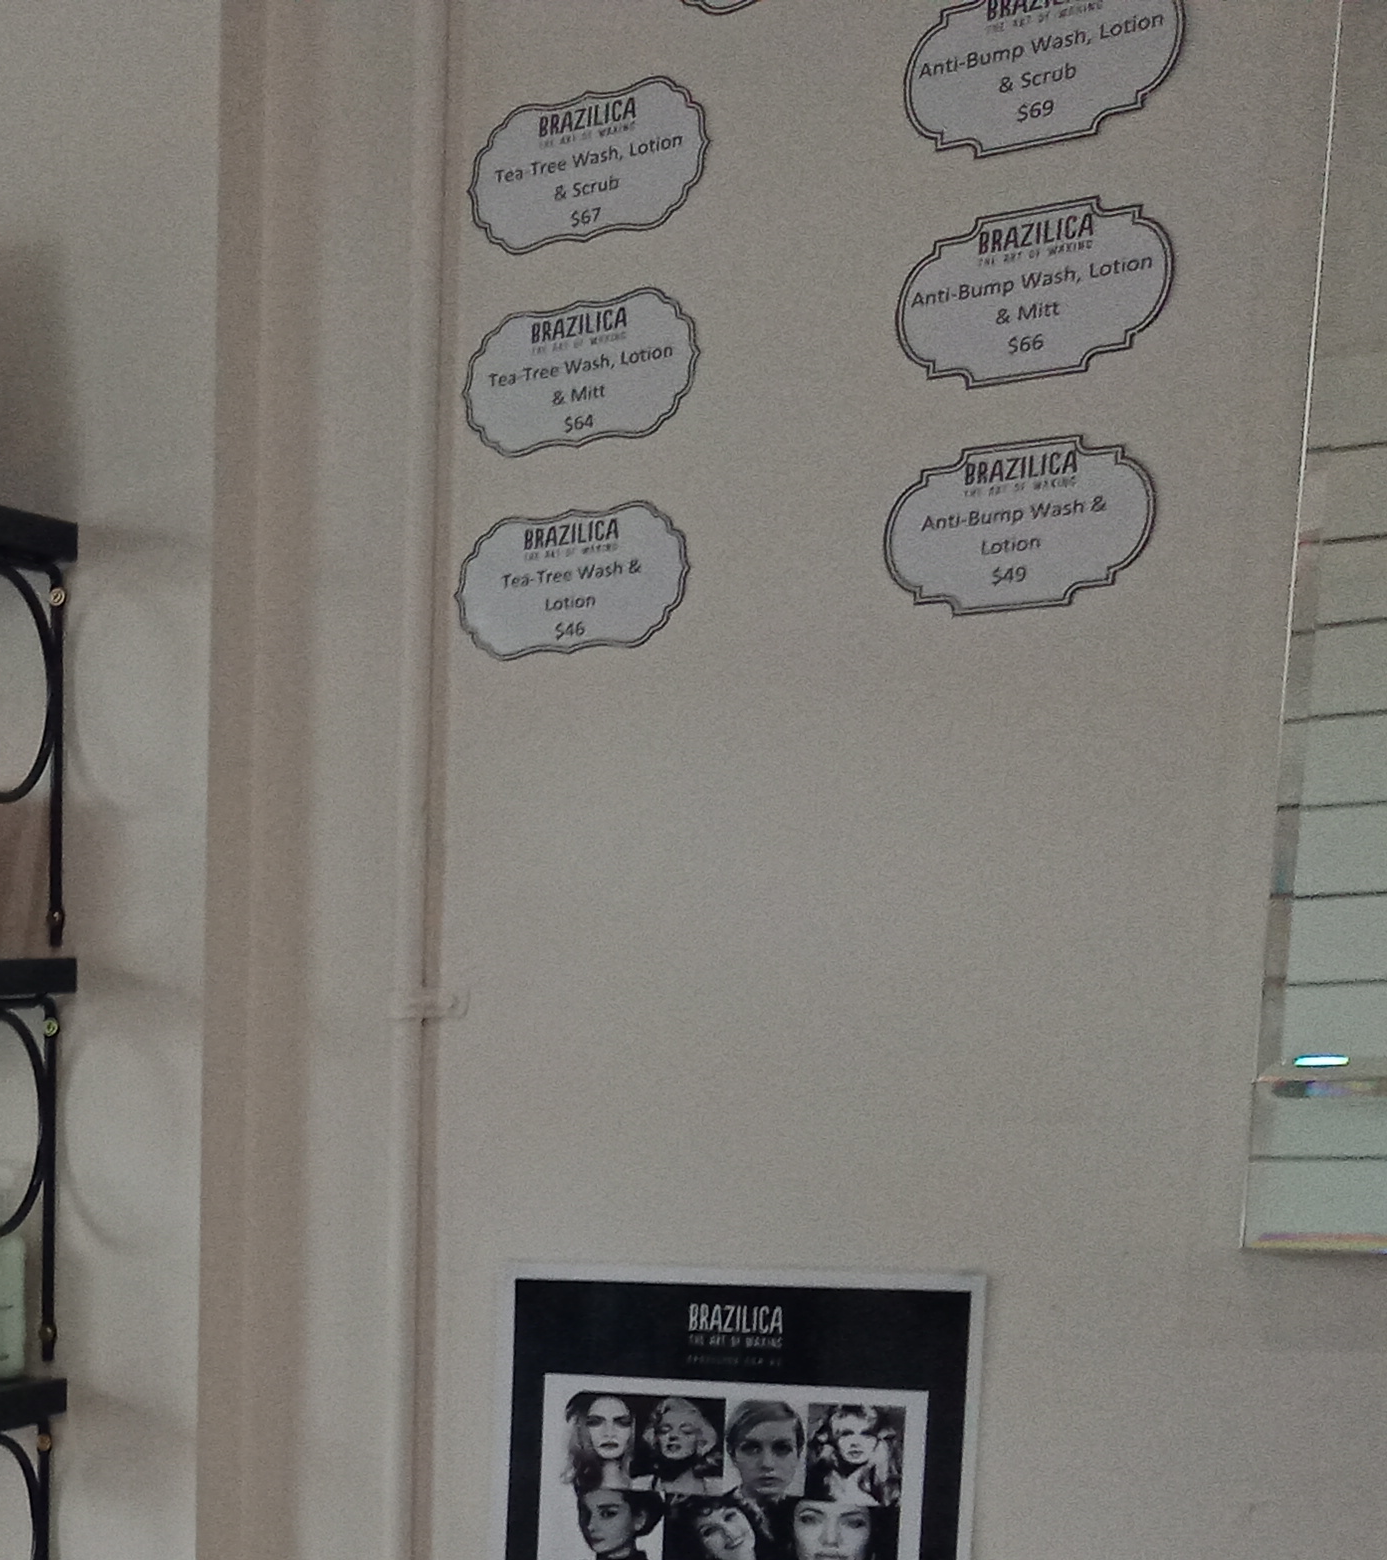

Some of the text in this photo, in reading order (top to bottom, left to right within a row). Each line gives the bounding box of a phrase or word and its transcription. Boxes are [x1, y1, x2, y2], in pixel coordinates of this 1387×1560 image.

[918, 13, 1165, 79] Anti-Bump Wash, Lotion
[999, 63, 1077, 94] & Scrub
[538, 97, 637, 138] BRAZILICA
[1016, 99, 1055, 123] $69
[572, 146, 624, 168] Wash,
[629, 134, 683, 157] Lotion
[554, 176, 620, 201] & Scrub
[571, 207, 602, 228] $67
[978, 213, 1094, 255] BRAZILICA
[911, 255, 1153, 308] Anti-Bump Wash, Lotion
[531, 306, 627, 344] BRAZILICA
[995, 301, 1061, 325] & Mitt
[1007, 334, 1044, 355] $66
[564, 354, 615, 374] Wash,
[620, 345, 673, 366] Lotion
[552, 385, 606, 406] & Mitt
[564, 414, 594, 434] $64
[964, 451, 1078, 486] BRAZILICA
[921, 496, 1107, 532] Anti-Bump Wash &
[523, 518, 620, 551] BRAZILICA
[981, 537, 1041, 556] Lotion
[578, 560, 623, 580] Wash
[628, 559, 642, 574] &
[992, 566, 1027, 587] $49
[544, 595, 597, 612] Lotion
[554, 621, 587, 641] $46
[688, 1303, 783, 1334] BRAZILICA
